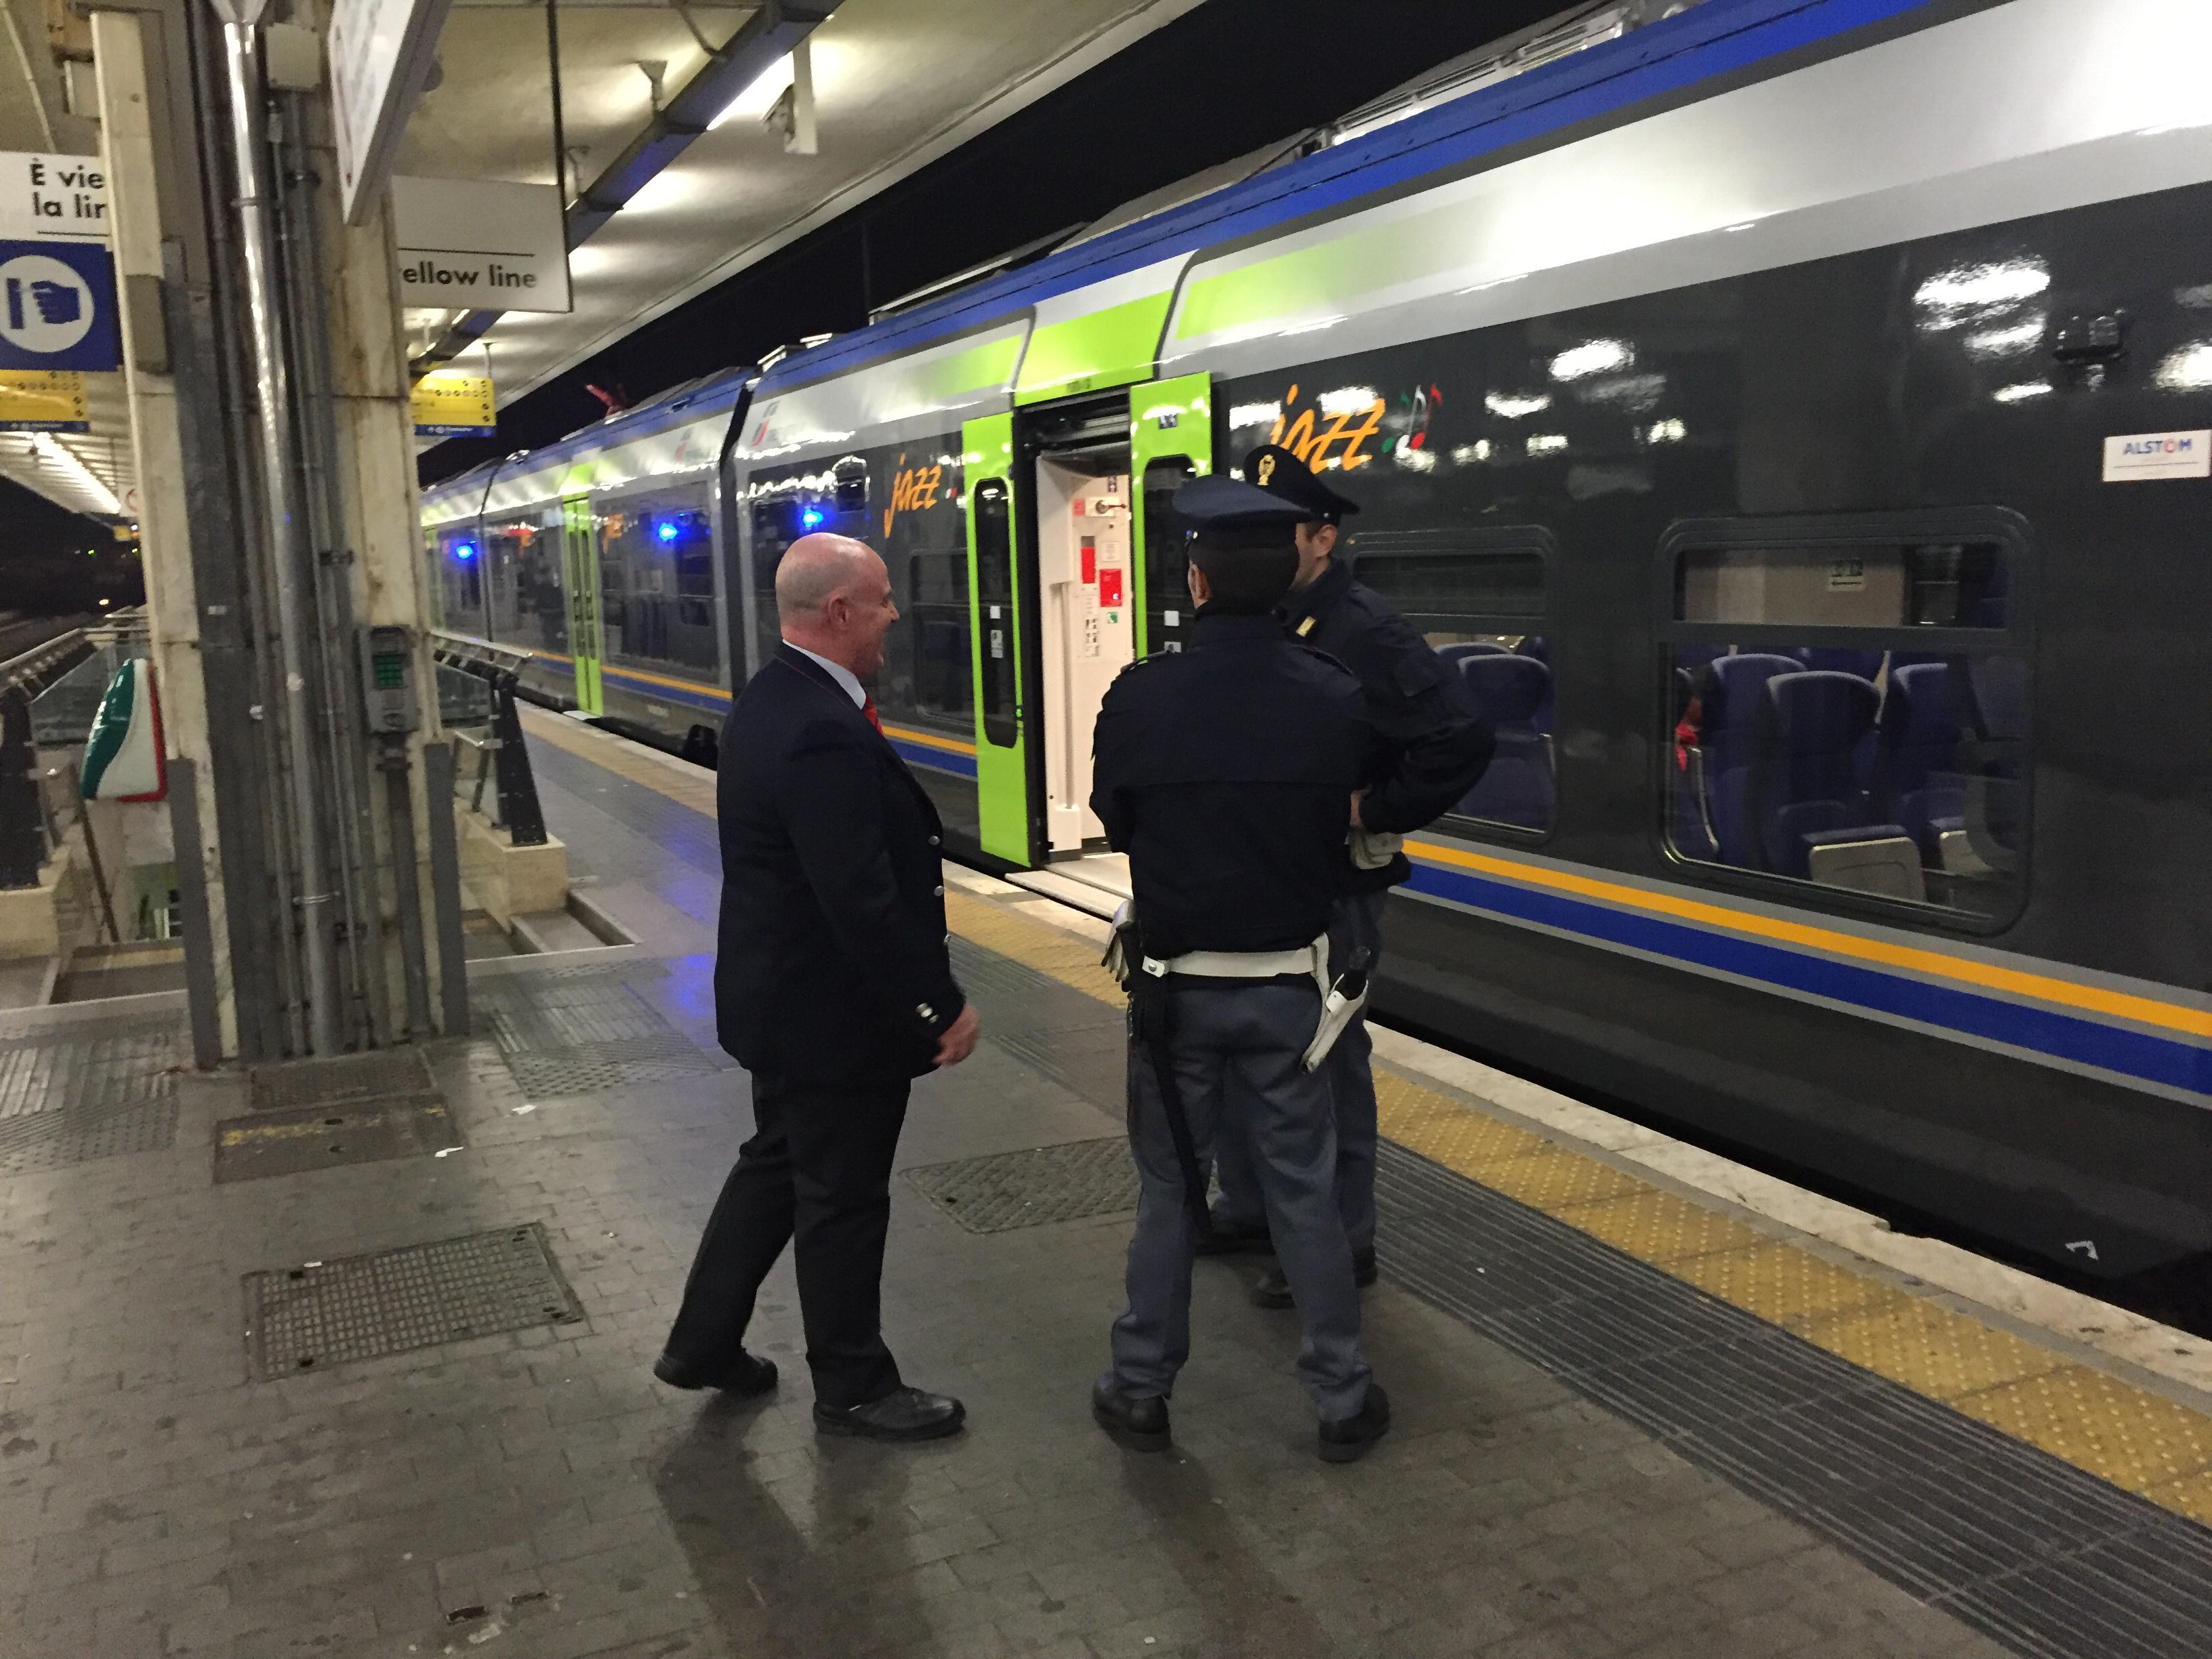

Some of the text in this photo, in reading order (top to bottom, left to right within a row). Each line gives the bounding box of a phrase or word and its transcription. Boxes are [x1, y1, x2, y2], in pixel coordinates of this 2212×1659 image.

[33, 191, 63, 217] la
[400, 260, 537, 287] ellow line
[2122, 438, 2193, 455] ALSTOM
[884, 452, 942, 539] jazz
